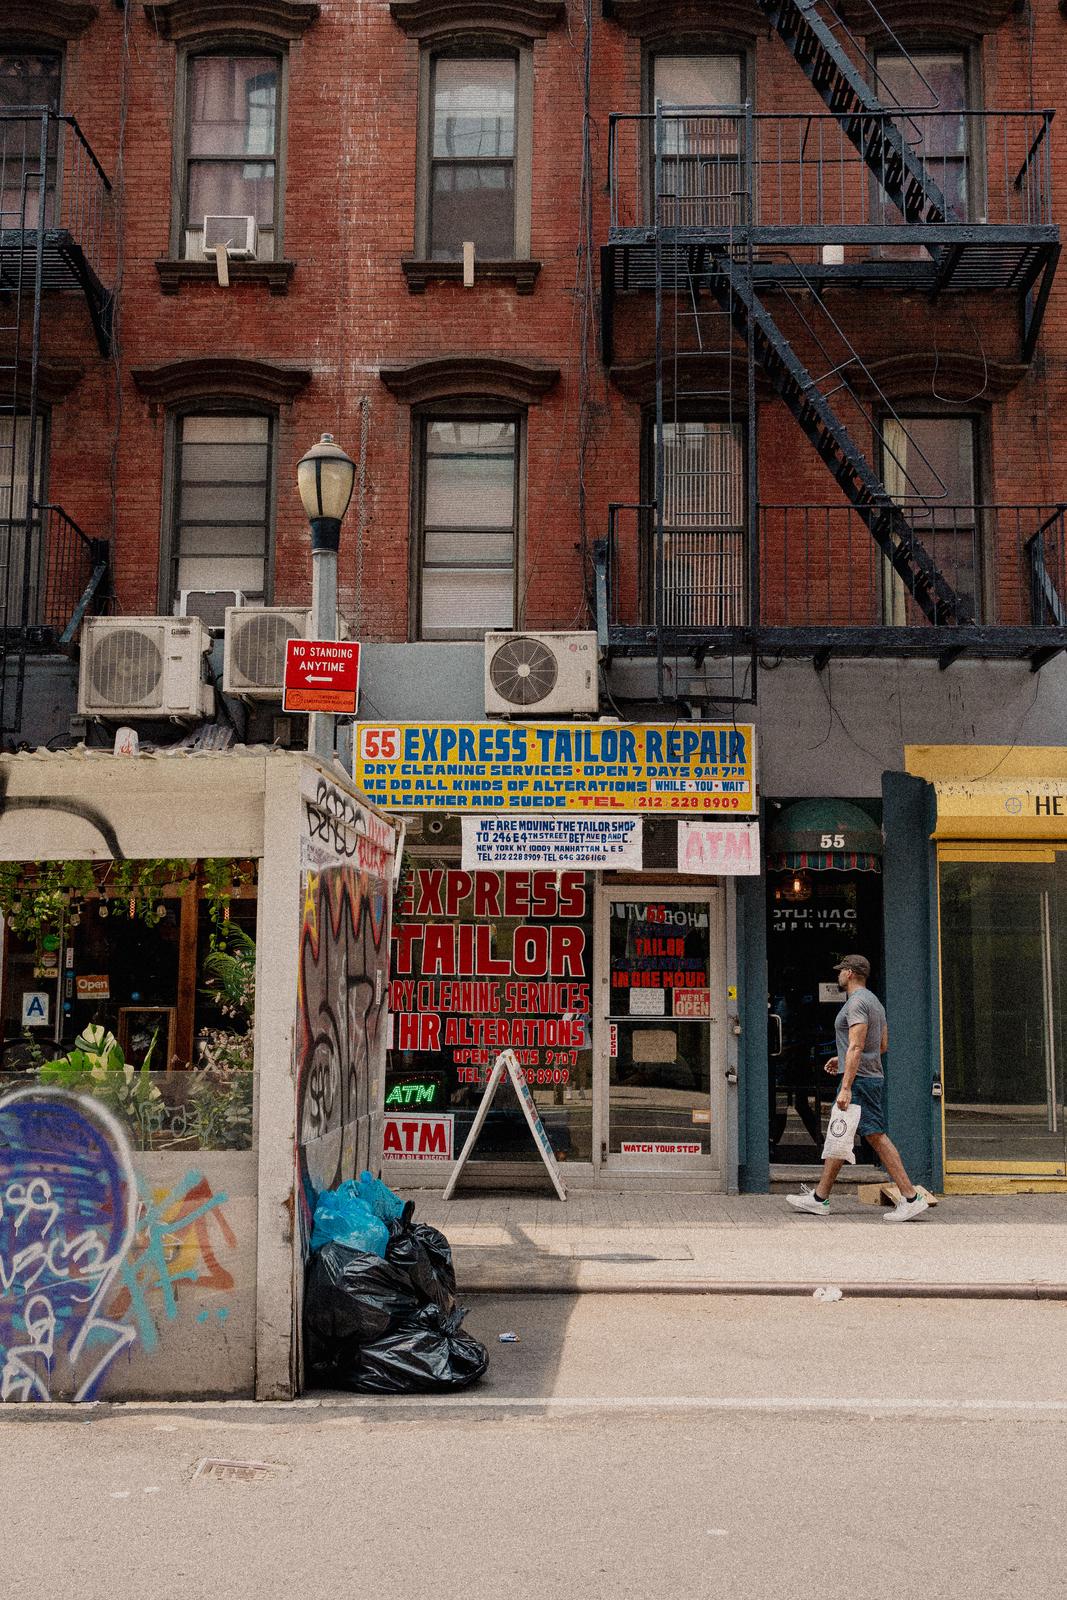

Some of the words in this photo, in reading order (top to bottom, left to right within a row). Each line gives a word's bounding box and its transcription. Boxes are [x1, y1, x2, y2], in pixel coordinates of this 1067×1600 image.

[293, 647, 305, 656] NO
[310, 647, 353, 658] STANDING
[299, 661, 345, 672] ANYTIME
[365, 731, 395, 758] 55
[404, 729, 527, 762] EXPRESS
[536, 730, 637, 763] TAILOR
[645, 730, 747, 764] REPAIR
[364, 764, 397, 775] DRY
[401, 764, 486, 776] CLEANING
[490, 765, 573, 776] SERVICES
[583, 766, 628, 777] OPEN
[632, 766, 643, 777] 7
[646, 766, 690, 777] DAYS
[363, 779, 387, 790] WE
[390, 779, 413, 790] DO
[415, 780, 448, 791] ALL
[453, 780, 503, 791] KINDS
[507, 780, 529, 791] OF
[533, 781, 647, 792] ALTERATIONS
[655, 781, 686, 792] WHILE
[695, 781, 713, 792] YOU
[722, 781, 744, 792] WAIT
[391, 795, 467, 806] LEATHER
[471, 795, 504, 806] AND
[509, 796, 566, 807] SUEDE
[578, 796, 625, 807] TEL
[671, 797, 698, 808] 228
[703, 797, 739, 808] 8909
[1036, 796, 1067, 815] HE
[480, 821, 495, 831] WE
[496, 821, 517, 831] ARE
[519, 821, 555, 831] MOVING
[557, 821, 575, 832] THE
[577, 821, 611, 832] TAILOR
[612, 821, 636, 832] SHOP
[476, 832, 489, 842] TO
[492, 832, 511, 843] 246
[569, 833, 585, 843] BET
[601, 833, 607, 843] B
[820, 834, 845, 849] 55
[685, 831, 753, 865] ATM
[477, 853, 493, 861] TEL
[544, 853, 557, 861] TEL
[391, 923, 586, 977] TAILOR
[635, 937, 685, 956] TAILOR
[77, 979, 108, 991] Open
[612, 971, 628, 987] IN
[631, 971, 660, 987] ONE
[663, 971, 705, 987] HOUR
[417, 980, 499, 1013] CLEANING
[505, 982, 590, 1014] SERVICES
[27, 996, 44, 1016] A
[676, 1001, 710, 1016] OPEN
[399, 1013, 441, 1051] HR
[445, 1018, 585, 1047] ALTERATIONS
[453, 1048, 489, 1064] OPEN
[513, 1049, 539, 1065] AYS
[457, 1067, 480, 1083] TEL
[386, 1084, 435, 1104] ATM
[384, 1121, 447, 1153] ATM
[623, 1144, 653, 1153] WATCH
[655, 1145, 675, 1153] YOUR
[677, 1145, 700, 1153] STEP
